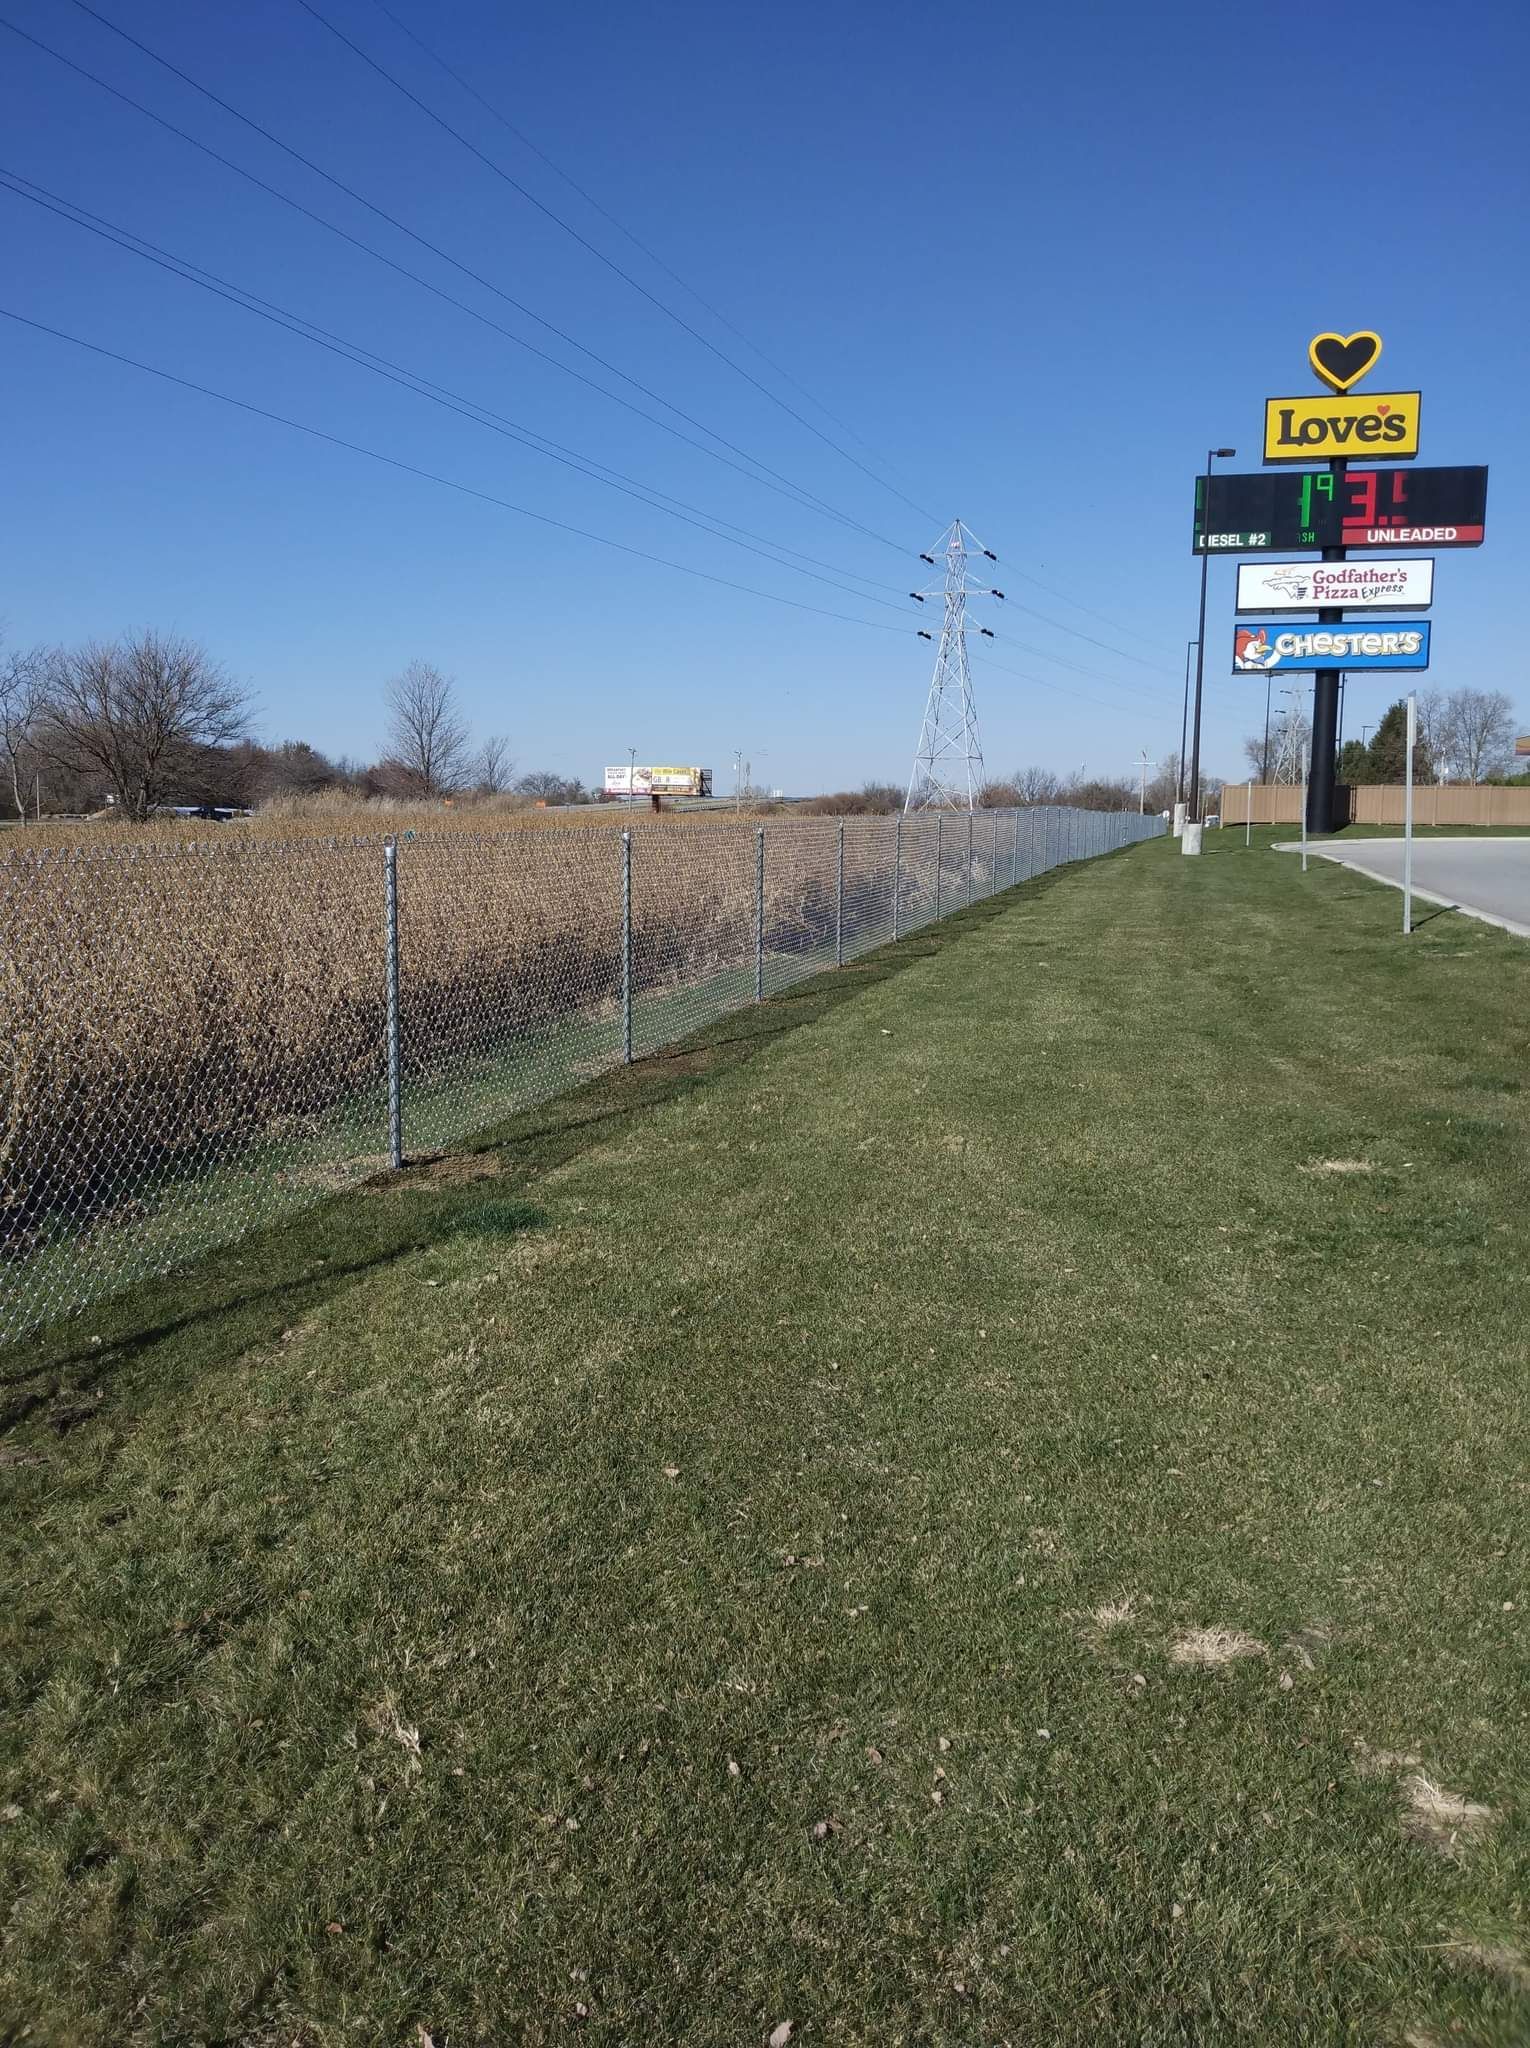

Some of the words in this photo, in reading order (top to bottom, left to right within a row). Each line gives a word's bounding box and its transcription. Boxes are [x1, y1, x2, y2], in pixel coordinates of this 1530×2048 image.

[1248, 533, 1266, 546] #2
[1367, 528, 1457, 543] UNLEADED
[1312, 568, 1408, 585] Godfather's
[1312, 585, 1359, 600] Pizza
[1361, 584, 1404, 599] Express
